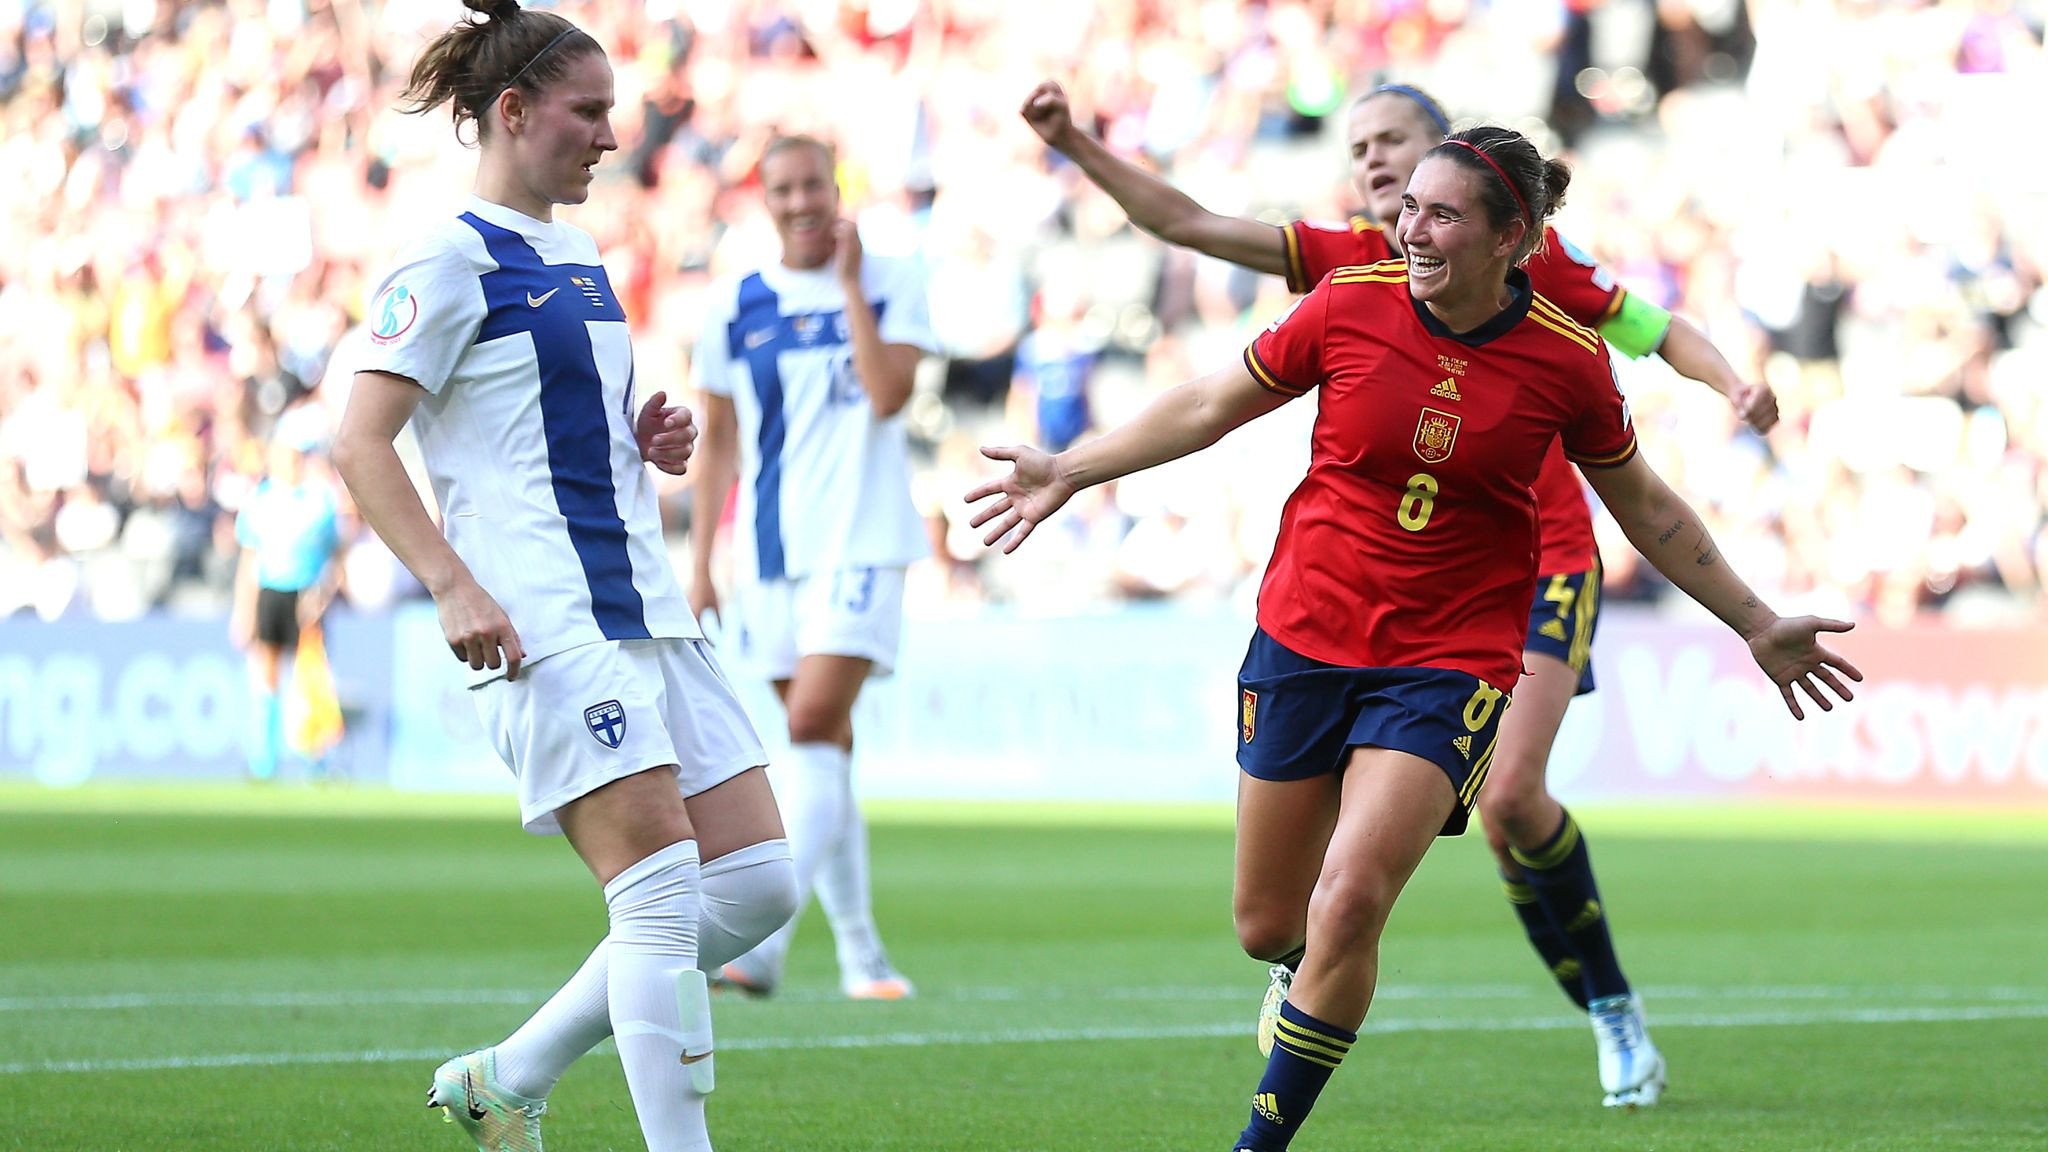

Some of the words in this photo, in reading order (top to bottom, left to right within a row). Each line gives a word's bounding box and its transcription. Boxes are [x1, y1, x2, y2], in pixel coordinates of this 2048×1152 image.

[1430, 388, 1461, 400] adidas
[1397, 473, 1438, 531] 8
[1544, 573, 1575, 619] 4
[1463, 679, 1502, 732] 8
[1617, 645, 2048, 780] Volksw
